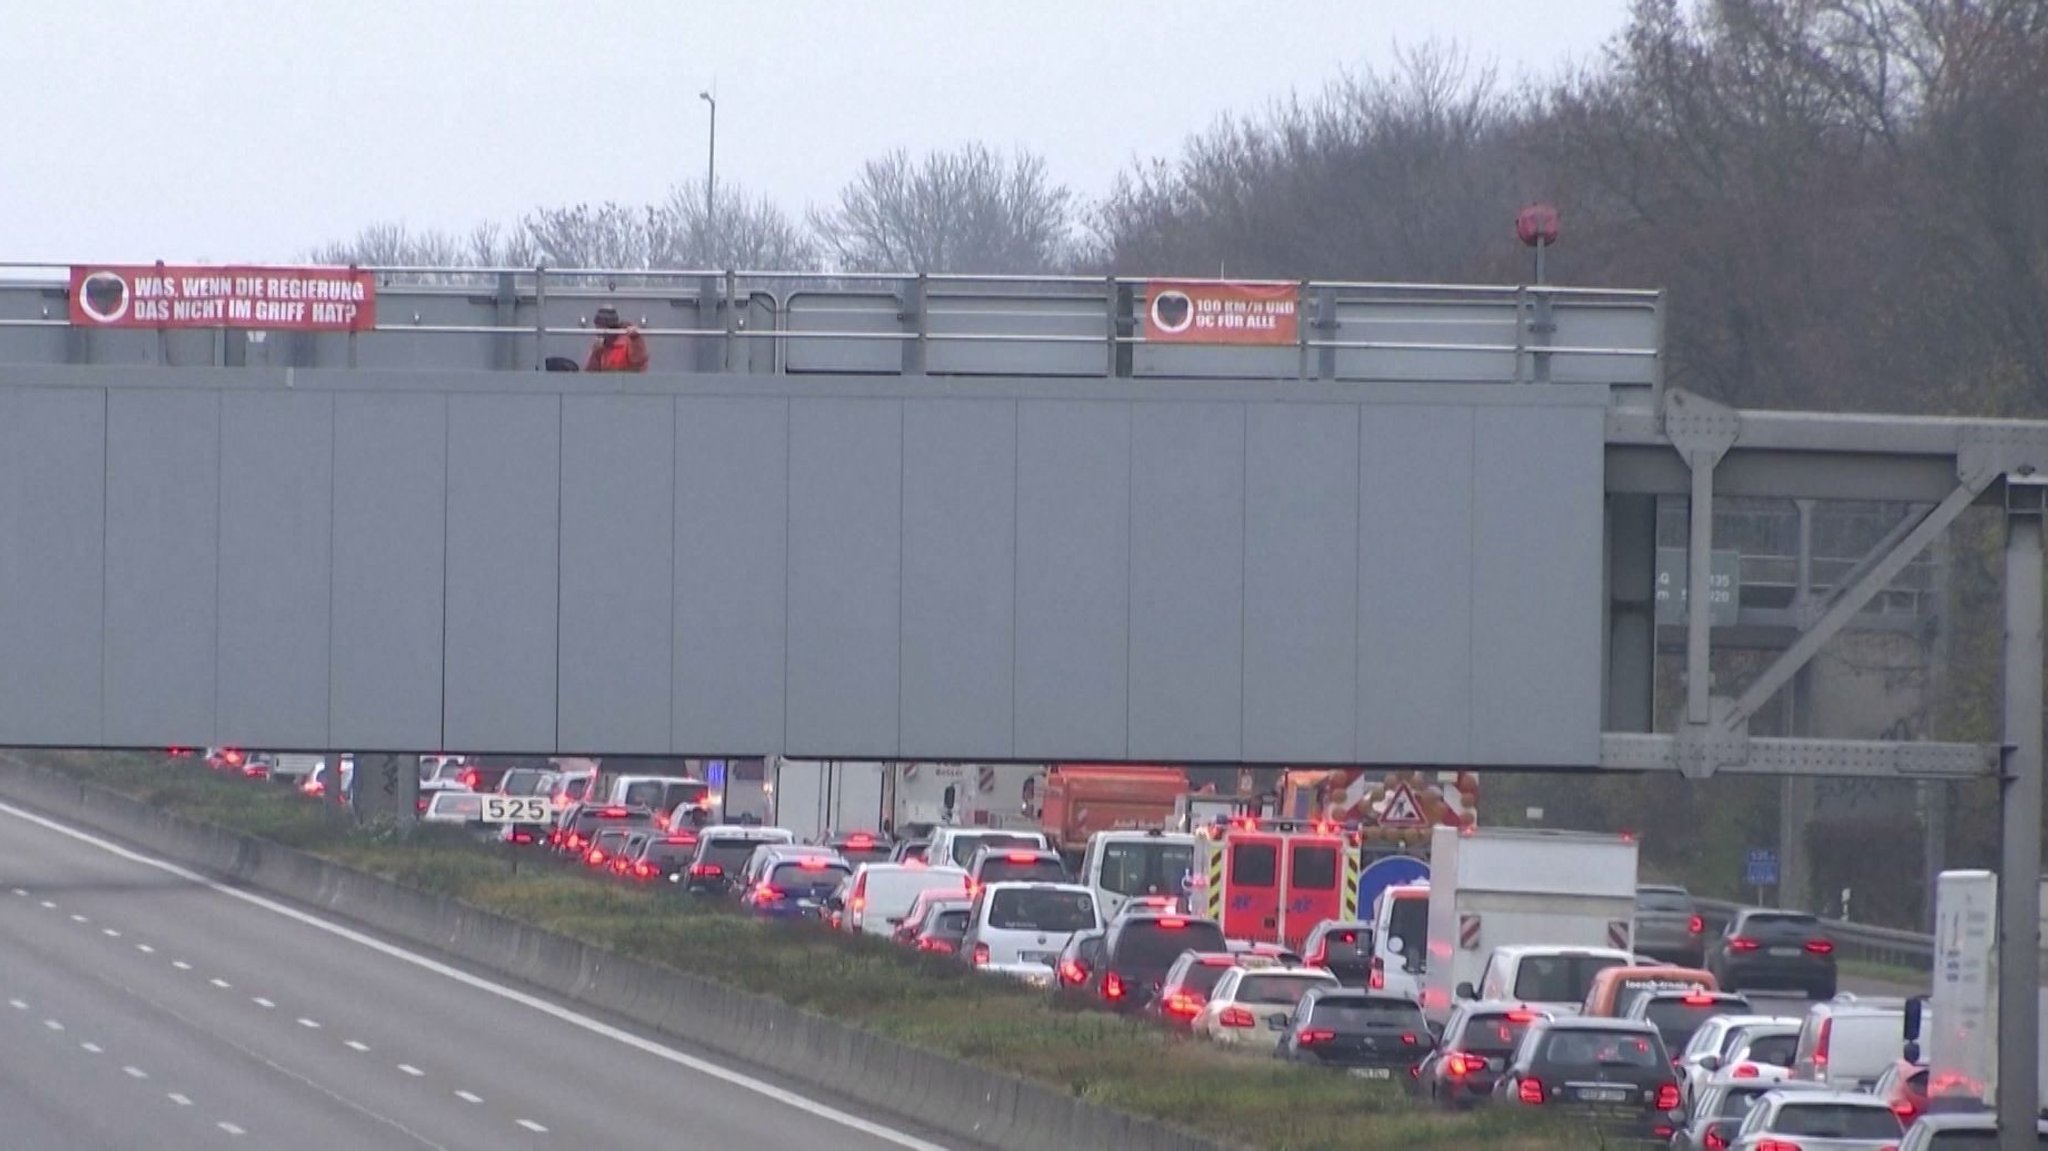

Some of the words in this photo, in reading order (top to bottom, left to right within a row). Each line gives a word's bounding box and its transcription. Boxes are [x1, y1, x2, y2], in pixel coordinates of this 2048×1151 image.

[135, 277, 178, 297] WAS,
[182, 277, 231, 297] WENN
[236, 278, 264, 297] DIE
[267, 280, 364, 300] REGIERUNG
[135, 300, 169, 319] DAS
[174, 300, 224, 319] NICHT
[229, 300, 251, 318] IM
[256, 301, 305, 321] GRIFF
[312, 302, 356, 322] HAT?
[1197, 300, 1221, 312] 100
[1266, 302, 1294, 314] UND
[1218, 314, 1243, 328] FÜR
[1247, 315, 1276, 328] ALLE
[489, 799, 544, 819] 525
